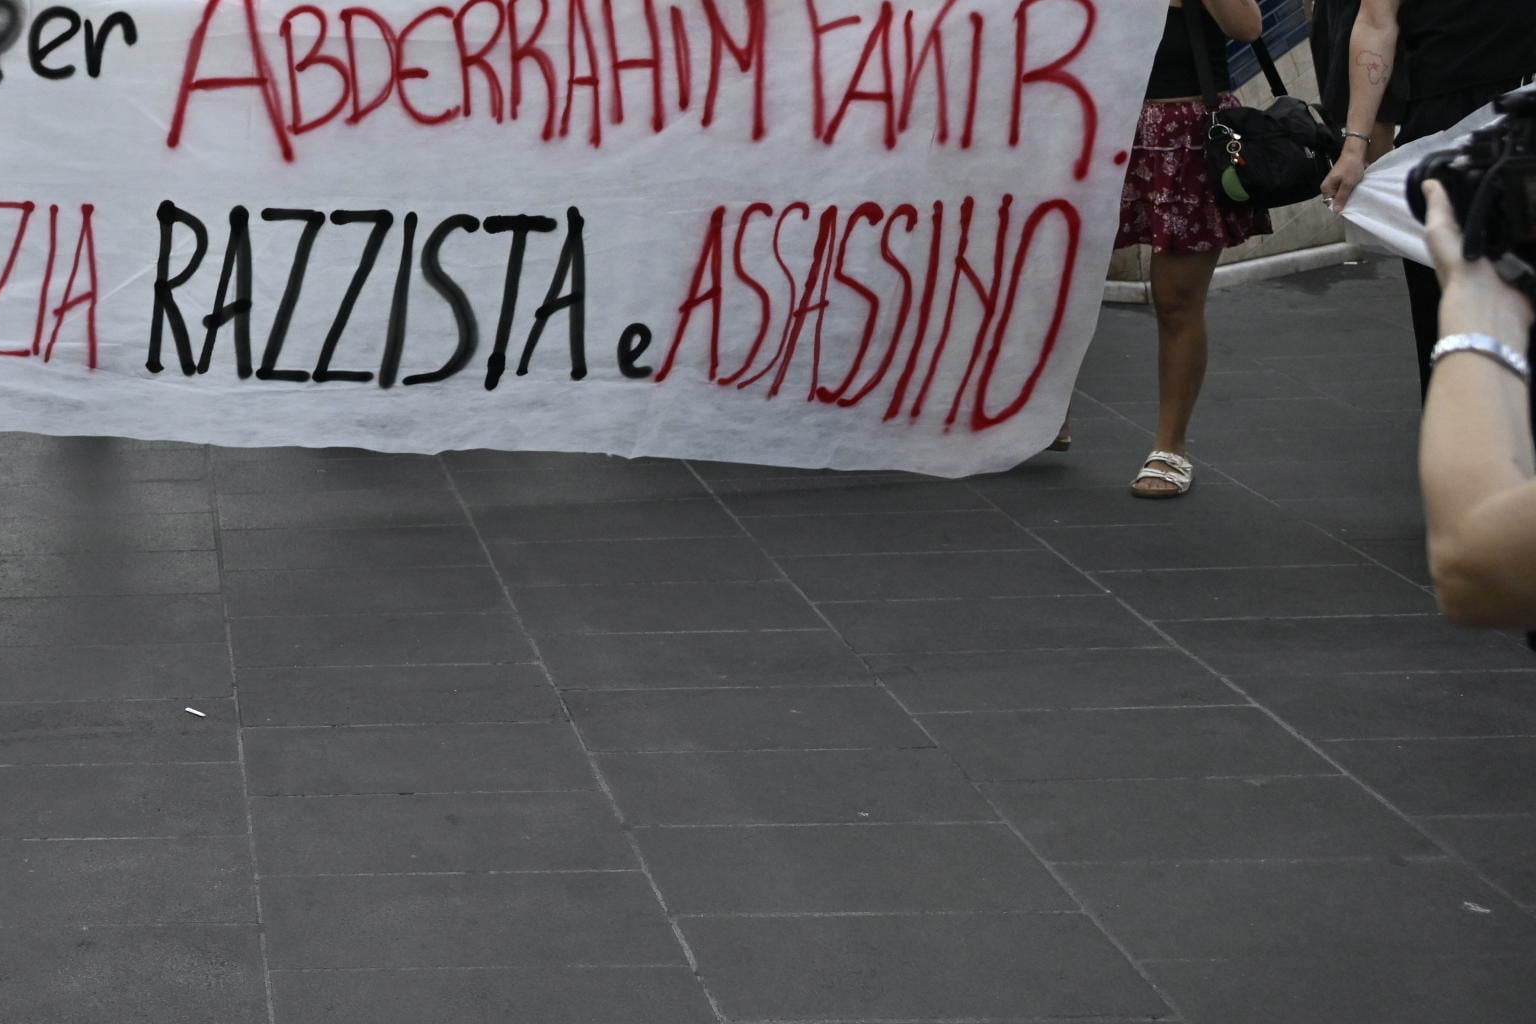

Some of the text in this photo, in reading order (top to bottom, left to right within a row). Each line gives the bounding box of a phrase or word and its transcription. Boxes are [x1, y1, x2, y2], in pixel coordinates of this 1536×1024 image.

[145, 199, 588, 392] RAZZISTA
[616, 322, 654, 380] e
[655, 194, 1082, 433] ASSASSINO
